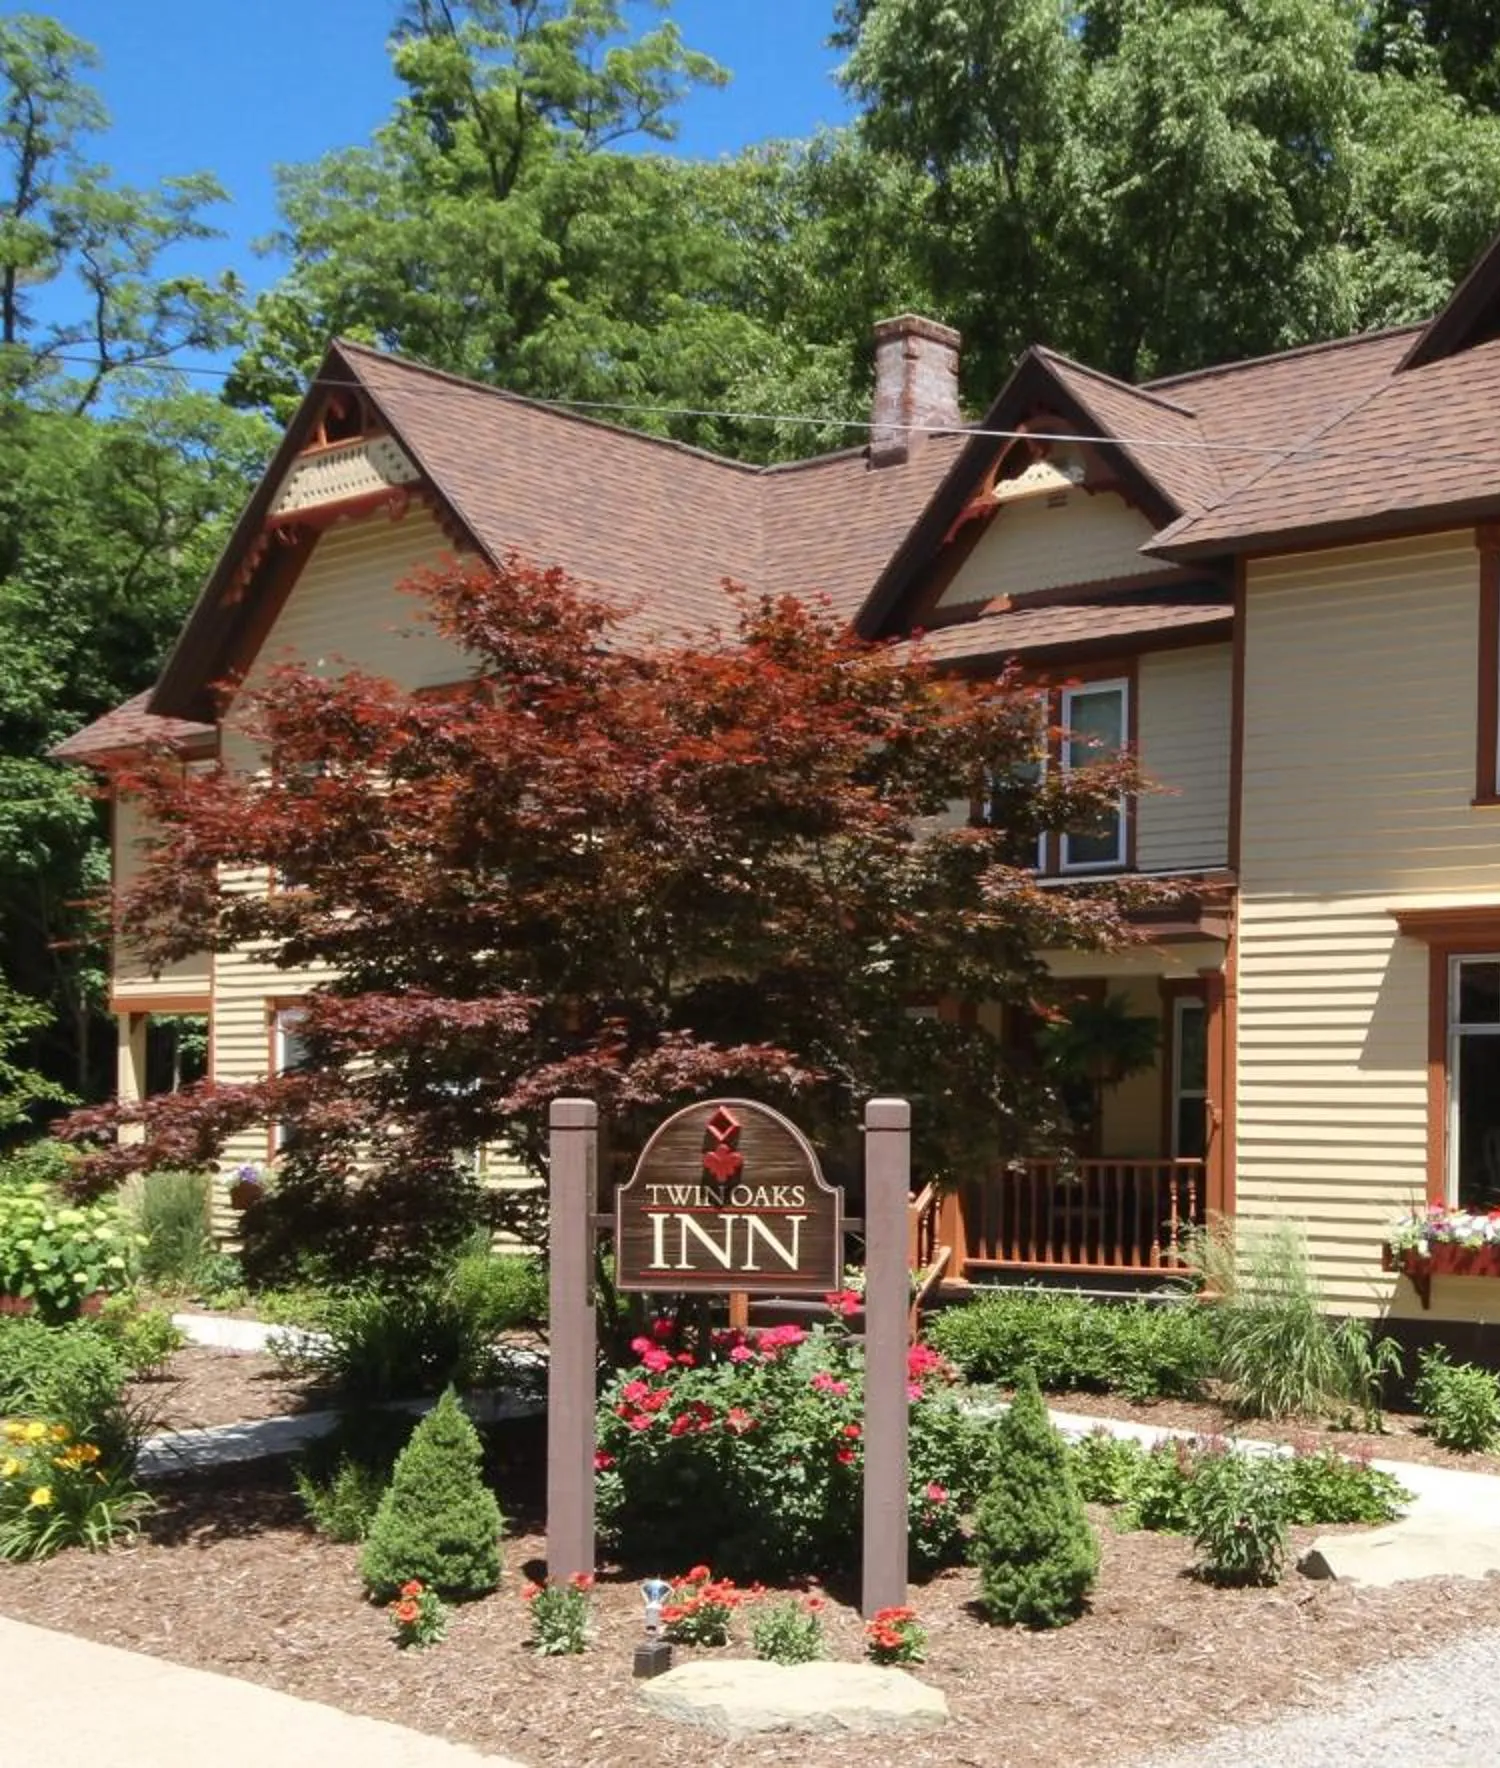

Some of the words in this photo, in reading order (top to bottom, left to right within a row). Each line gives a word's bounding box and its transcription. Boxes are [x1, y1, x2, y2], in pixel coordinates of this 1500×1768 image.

[646, 1184, 725, 1207] TWIN
[731, 1185, 805, 1207] OAKS
[648, 1213, 807, 1270] INN
